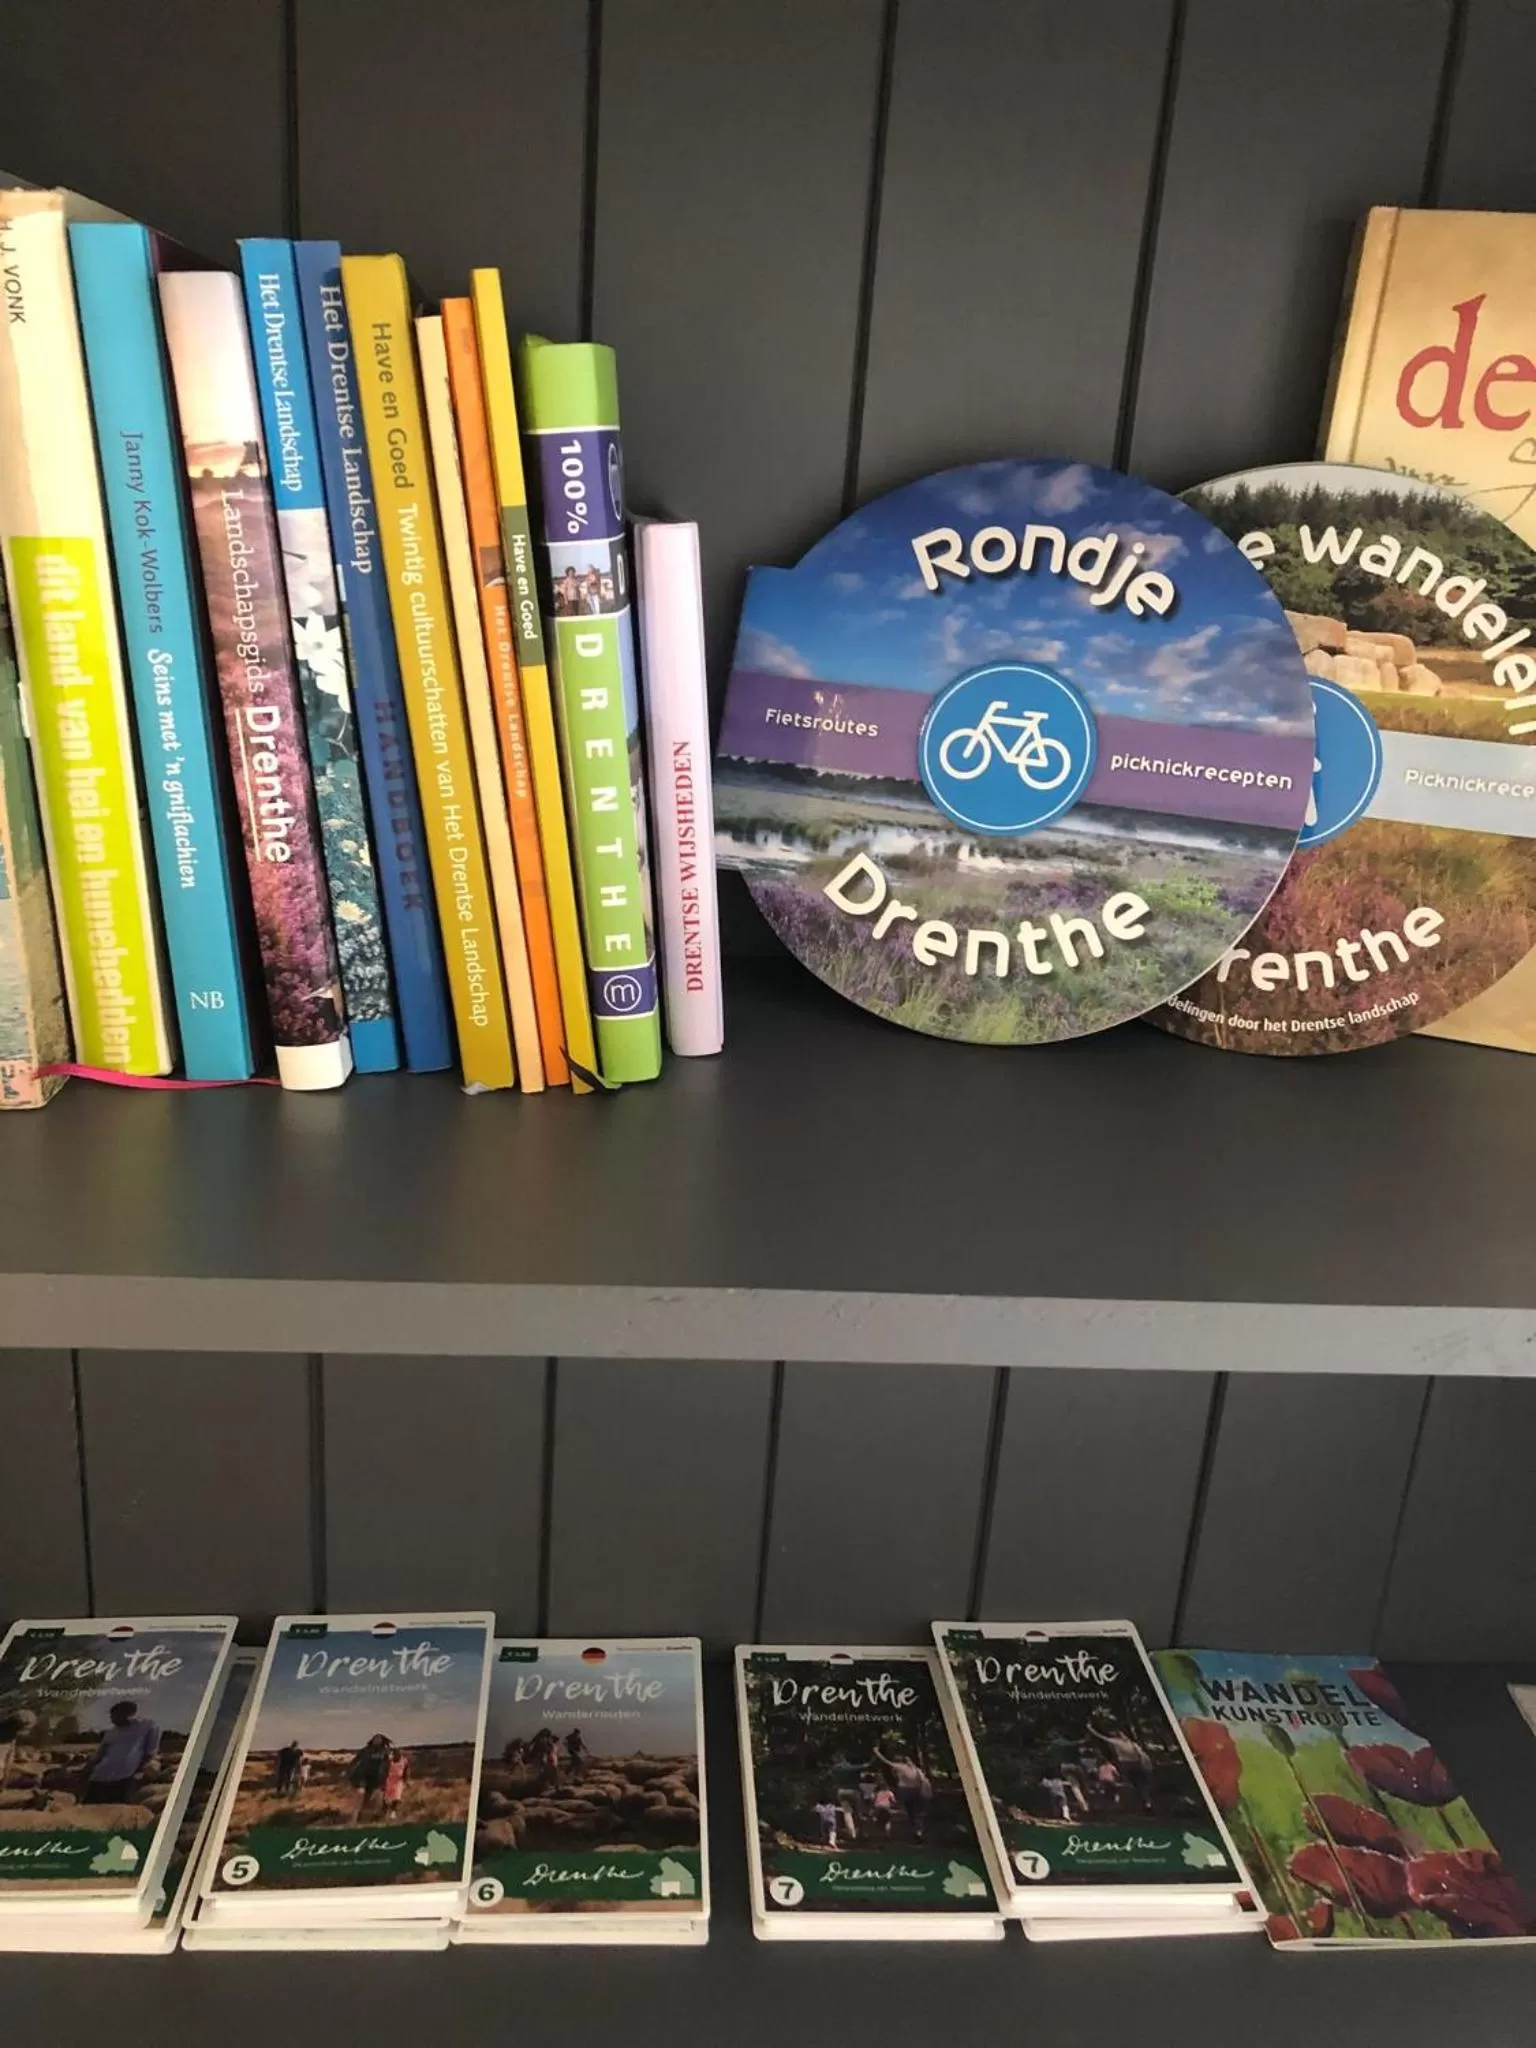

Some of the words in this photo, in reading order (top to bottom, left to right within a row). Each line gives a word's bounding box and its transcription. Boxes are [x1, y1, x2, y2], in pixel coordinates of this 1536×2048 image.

[3, 264, 27, 324] VONK
[258, 273, 281, 313] Het
[319, 284, 341, 332] Het
[264, 313, 290, 390] Drentse
[371, 323, 395, 383] Have
[328, 342, 356, 439] Drentse
[382, 391, 400, 420] en
[120, 430, 145, 494] Janny
[272, 389, 303, 493] Landschap
[386, 428, 415, 490] Goed
[560, 439, 589, 534] 100%
[342, 447, 376, 574] Landschap
[396, 502, 424, 586] Twintig
[511, 534, 527, 573] Have
[127, 500, 163, 634] Kok-Wolbers
[517, 576, 530, 596] en
[911, 523, 1176, 618] Rondje
[520, 599, 539, 640] Goed
[43, 611, 94, 686] land
[147, 648, 174, 706] Seins
[220, 489, 266, 694] Landschapsgids
[246, 705, 291, 865] Drenthe
[408, 591, 450, 756] cultuurschatten
[56, 698, 94, 761] van
[158, 710, 182, 752] met
[764, 707, 879, 738] Fietsroutes
[65, 767, 113, 819] hei
[436, 761, 455, 799] van
[1110, 752, 1293, 791] picknickrecepten
[1404, 768, 1536, 799] Picknickrece
[575, 633, 633, 954] DRENTHE
[673, 740, 698, 881] WIJSHEDEN
[73, 822, 107, 864] en
[442, 805, 465, 841] Het
[448, 847, 474, 922] Drentse
[822, 851, 1151, 979] Drenthe
[684, 885, 705, 993] DRENTSE
[1216, 906, 1446, 992] renthe
[81, 869, 137, 1064] hunebedden
[461, 928, 490, 1028] Landschap
[189, 990, 225, 1010] NB
[1167, 994, 1226, 1024] delingen
[1228, 1014, 1261, 1032] door
[1263, 1019, 1288, 1034] het
[1290, 1017, 1346, 1034] Drentse
[1348, 990, 1420, 1026] landschap
[18, 1644, 184, 1683] Drenthe
[295, 1640, 455, 1681] Drenthe
[974, 1650, 1121, 1686] Drenthe
[513, 1667, 667, 1703] Drenthe
[771, 1672, 919, 1709] Drenthe
[1200, 1679, 1374, 1707] WANDEL
[1211, 1705, 1384, 1728] KUNSTROUTE
[279, 1837, 409, 1861] Drenthe
[1021, 1855, 1041, 1874] 7
[1061, 1834, 1172, 1857] Drenthe
[230, 1860, 251, 1879] 5
[522, 1862, 645, 1887] Drenthe
[777, 1881, 795, 1900] 7
[818, 1861, 935, 1883] Drenthe
[477, 1883, 495, 1901] 6
